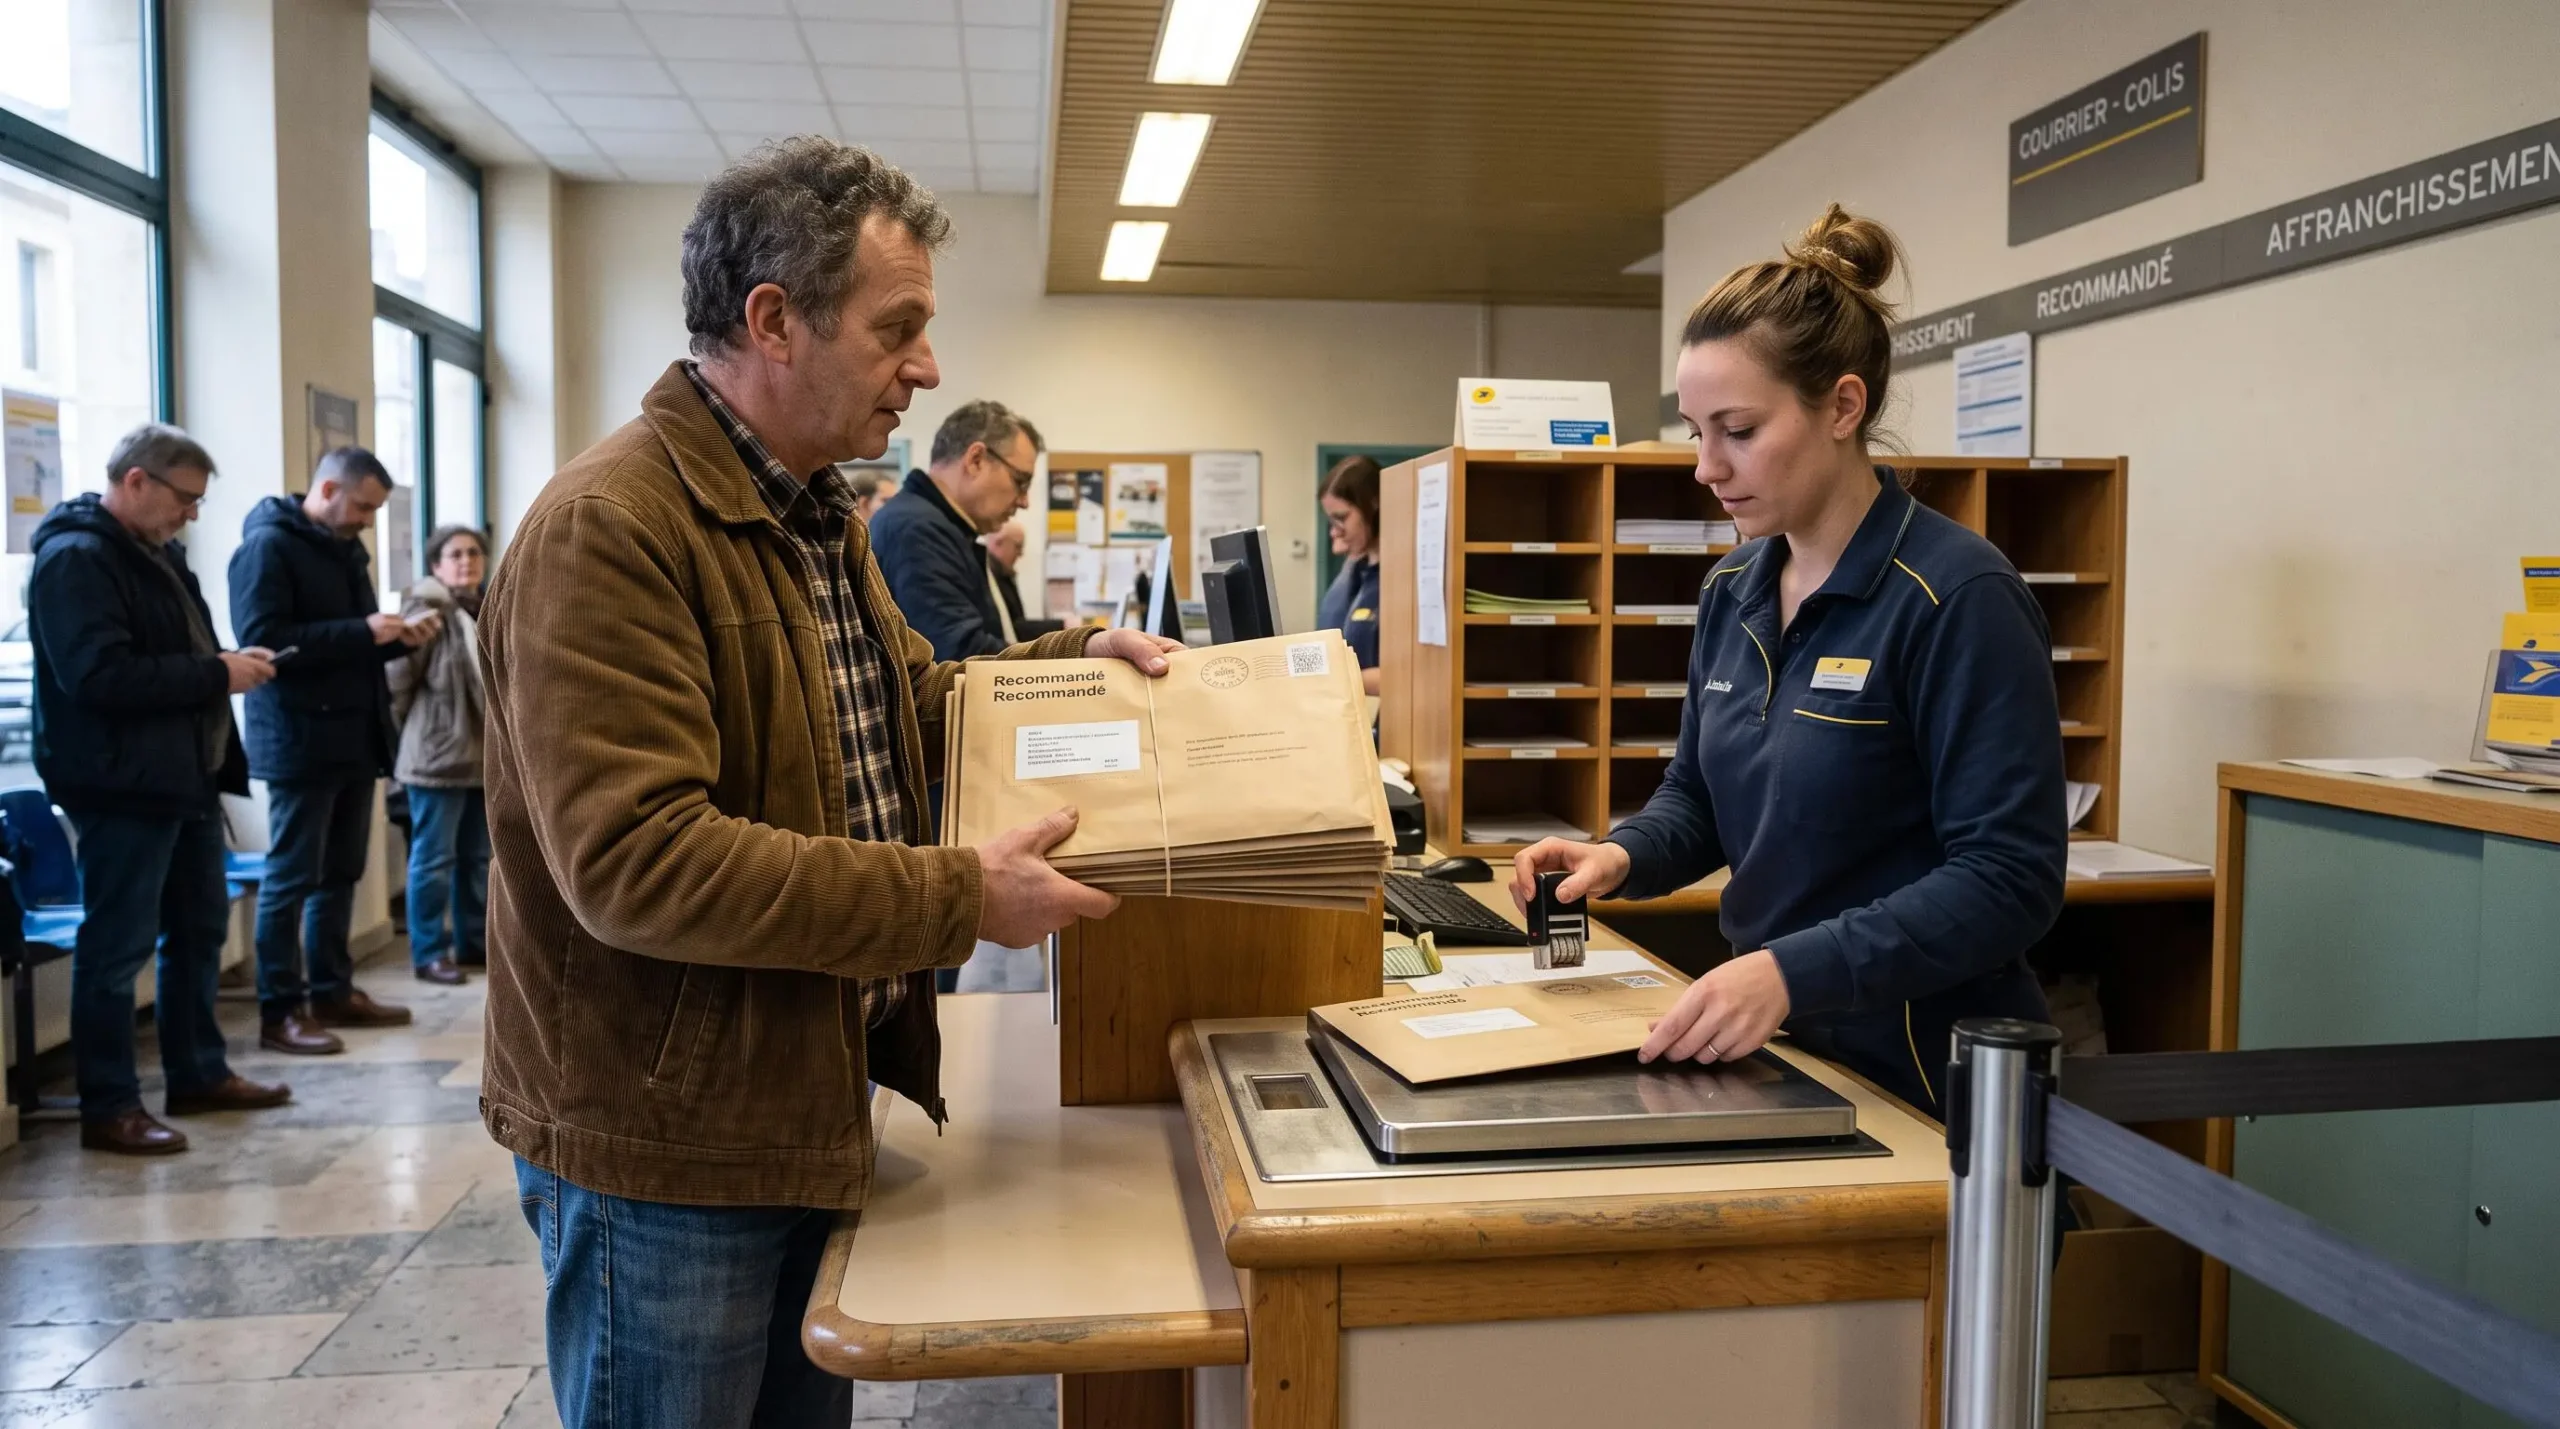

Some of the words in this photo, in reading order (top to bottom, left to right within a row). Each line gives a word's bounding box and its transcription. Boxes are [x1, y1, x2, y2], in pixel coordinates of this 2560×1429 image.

[2019, 97, 2108, 160] COURRIER
[2123, 62, 2185, 113] COLIS
[2037, 246, 2174, 319] RECOMMANDÉ
[993, 685, 1107, 702] Recommandé
[994, 670, 1106, 687] Recommandé
